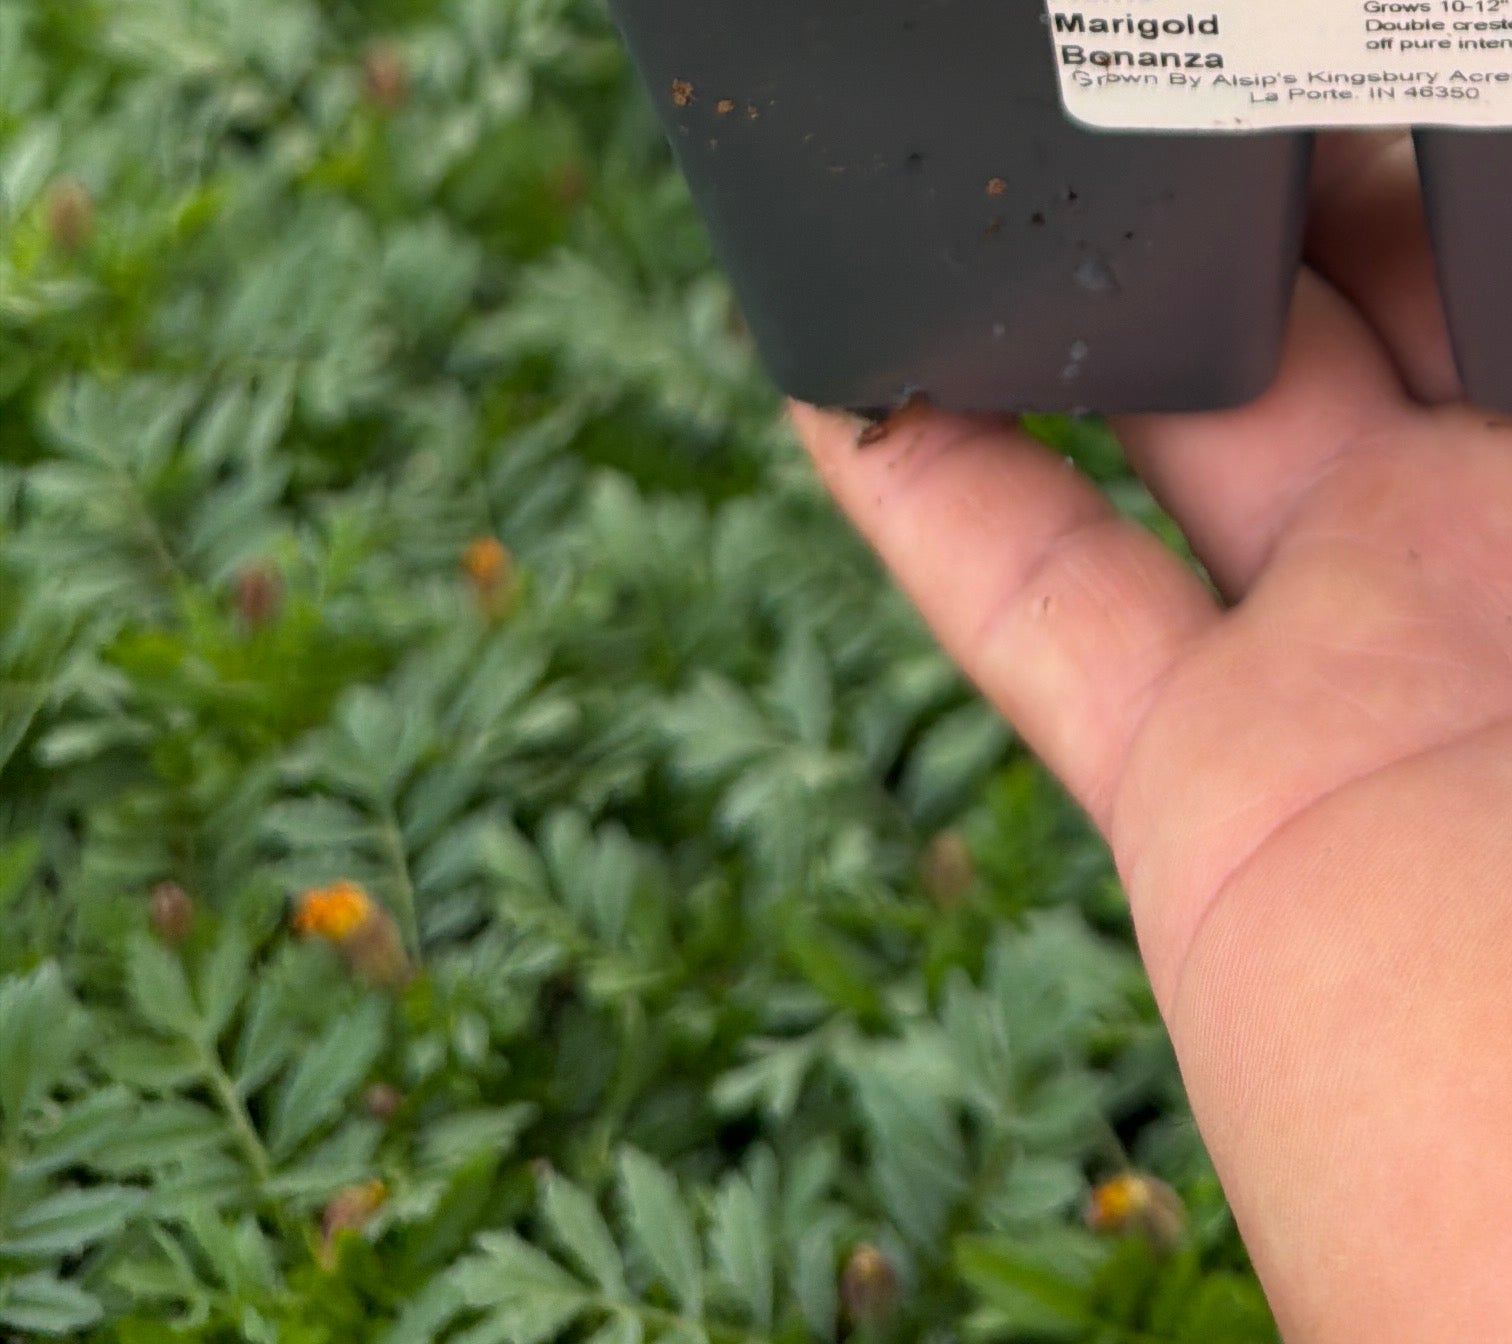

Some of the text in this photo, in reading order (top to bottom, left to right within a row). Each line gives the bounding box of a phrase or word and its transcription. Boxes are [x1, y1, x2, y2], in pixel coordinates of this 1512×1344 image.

[1363, 0, 1431, 13] Grows
[1054, 13, 1219, 39] Marigold
[1365, 18, 1446, 32] Double
[1366, 37, 1393, 50] off
[1399, 38, 1452, 52] pure
[1061, 44, 1224, 68] Bonanza
[1072, 69, 1158, 87] Grown
[1169, 72, 1202, 88] By
[1212, 71, 1298, 88] Alsip's
[1307, 70, 1440, 86] Kingsbury
[1250, 91, 1279, 103] La
[1370, 87, 1395, 99] IN
[1404, 85, 1480, 100] 46350
